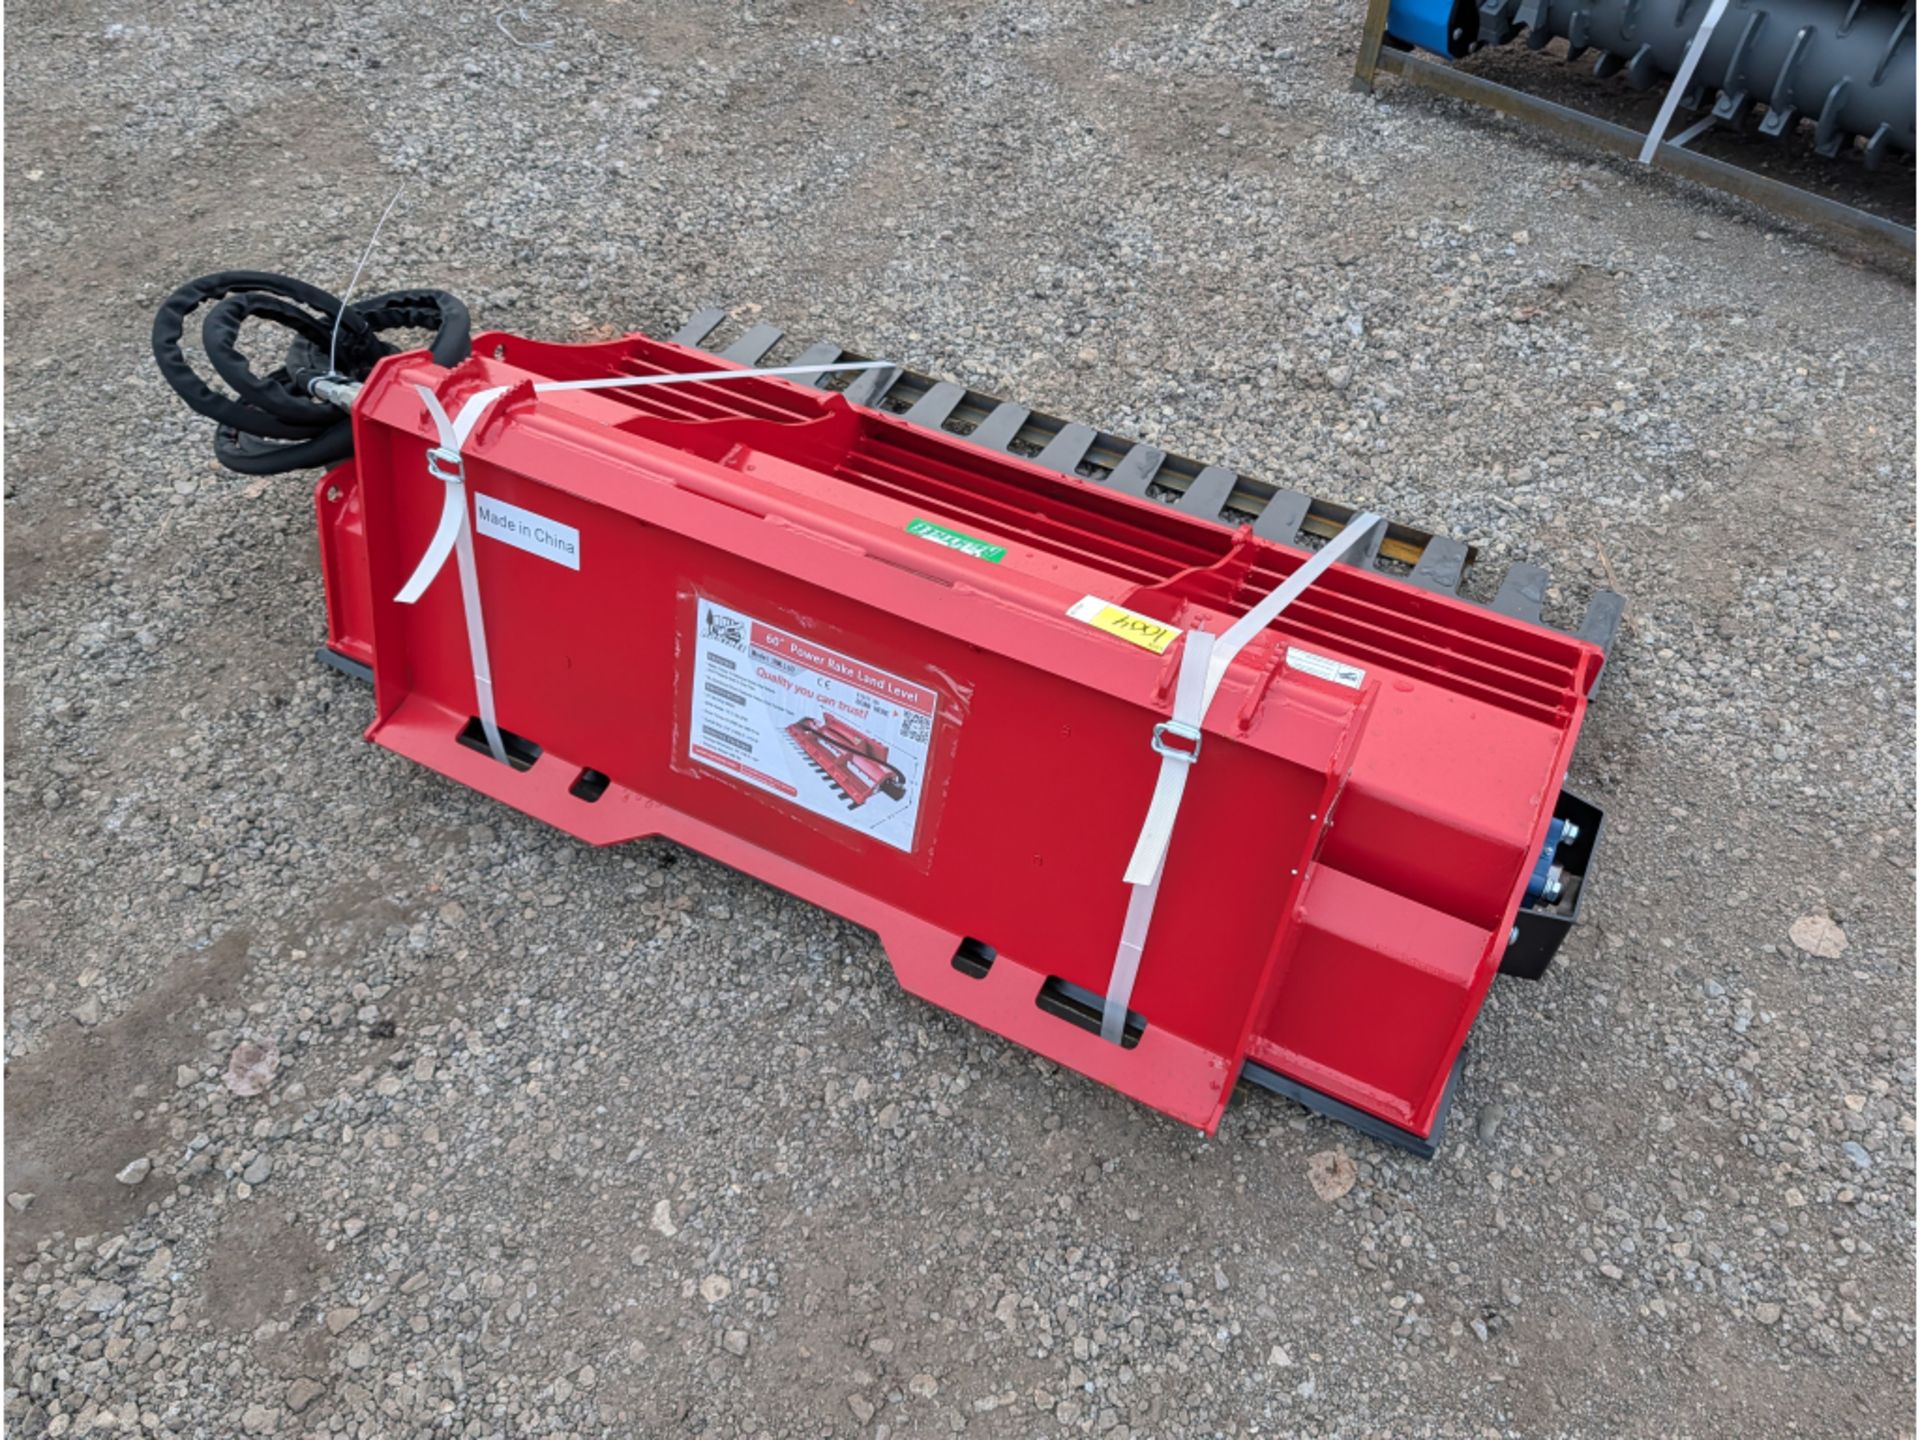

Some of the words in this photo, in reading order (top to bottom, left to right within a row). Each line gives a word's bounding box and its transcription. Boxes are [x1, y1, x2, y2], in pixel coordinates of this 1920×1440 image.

[479, 505, 515, 532] Made
[518, 520, 532, 538] in
[534, 528, 575, 554] China
[756, 666, 792, 690] Quality
[794, 685, 815, 699] you
[816, 694, 836, 707] can
[838, 700, 869, 720] trust!
[790, 642, 824, 665] Power
[827, 657, 854, 678] Rake
[857, 670, 885, 689] Land
[888, 681, 918, 703] Level
